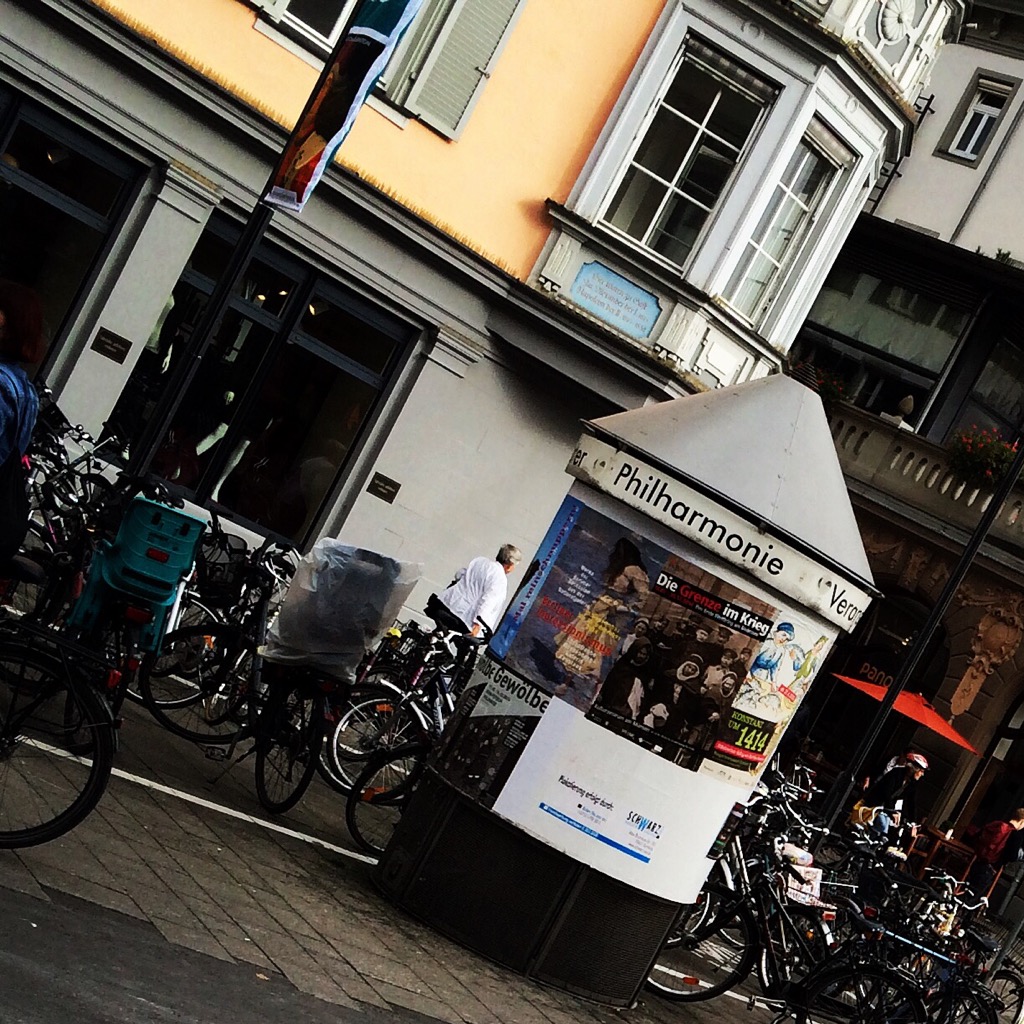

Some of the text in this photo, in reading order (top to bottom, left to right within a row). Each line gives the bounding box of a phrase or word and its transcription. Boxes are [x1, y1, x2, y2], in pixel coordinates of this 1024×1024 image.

[570, 449, 588, 467] er
[613, 462, 784, 576] Philharmonie
[657, 573, 679, 593] Die
[680, 584, 722, 612] Grenze
[722, 603, 739, 620] im
[740, 611, 771, 637] Krieg
[493, 667, 549, 714] Gewölbe
[728, 719, 742, 731] UM
[735, 726, 769, 752] 1414
[626, 811, 662, 835] SCHWARZ
